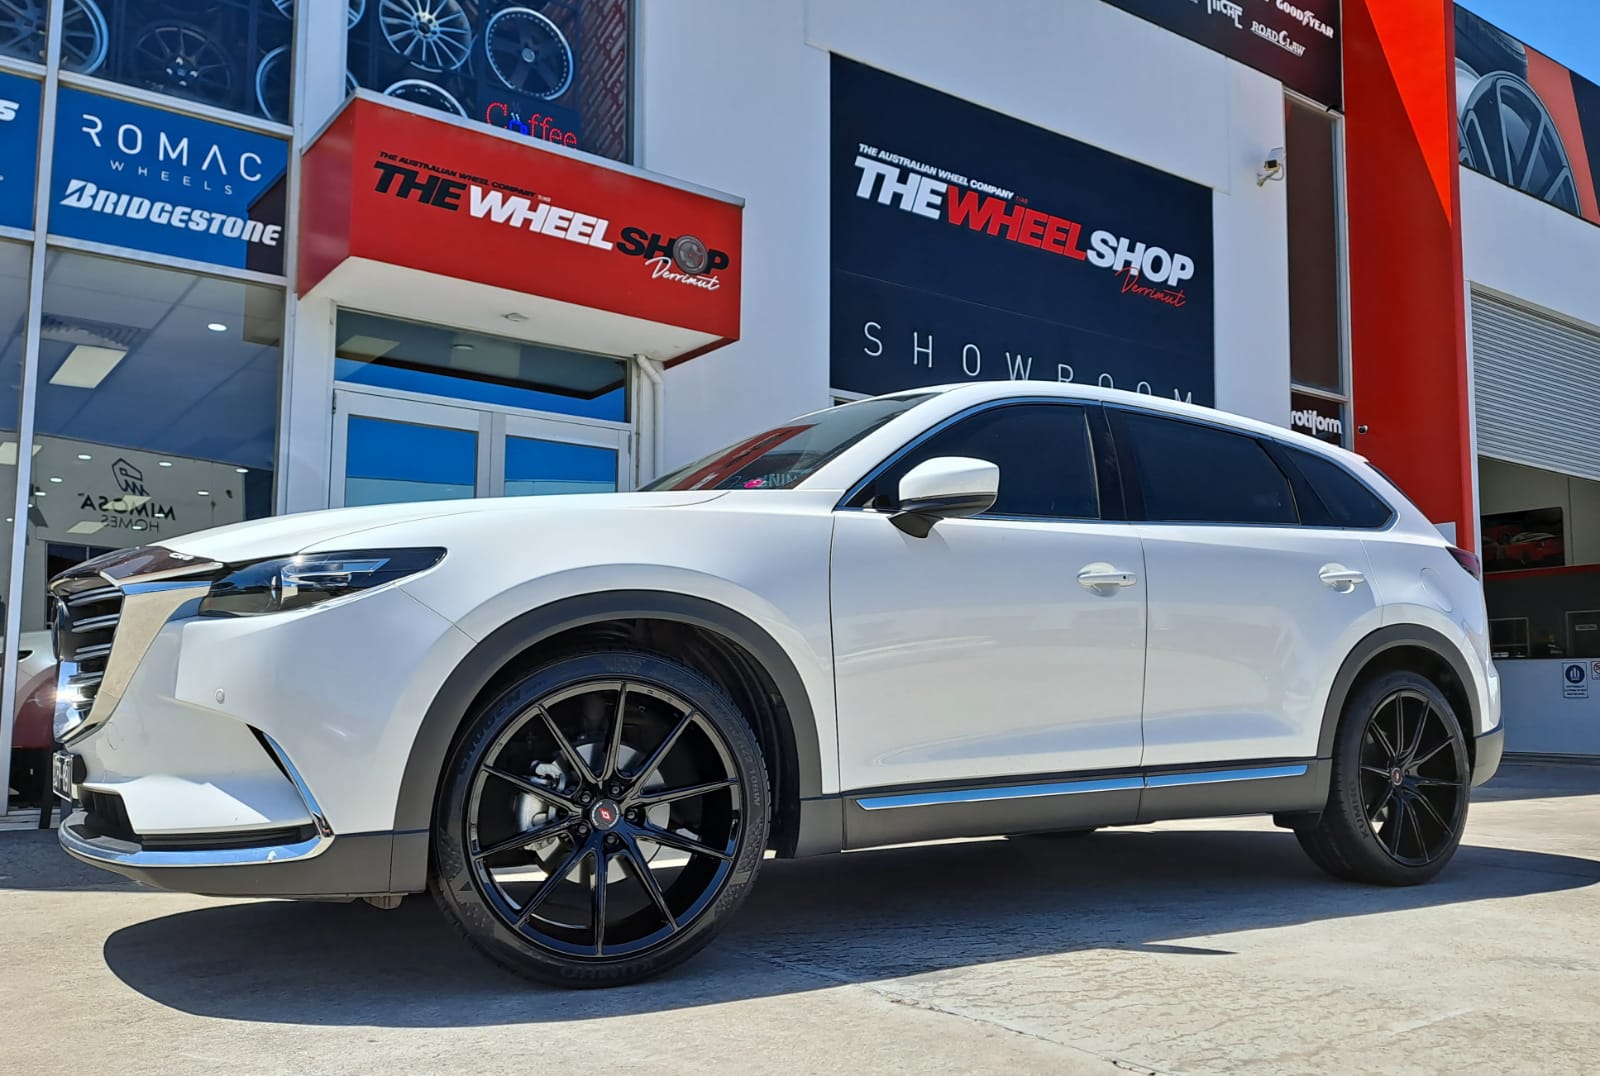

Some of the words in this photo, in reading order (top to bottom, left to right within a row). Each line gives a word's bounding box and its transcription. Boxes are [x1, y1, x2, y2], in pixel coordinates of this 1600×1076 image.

[1276, 0, 1334, 38] GOODYEAR
[80, 113, 263, 182] ROMAC
[110, 159, 233, 195] WHEELS
[379, 151, 397, 162] THE
[398, 156, 457, 178] AUSTRALIAN
[458, 172, 489, 188] WHEEL
[491, 180, 537, 198] COMPANY
[858, 143, 878, 157] THE
[878, 150, 937, 175] AUSTRALIAN
[938, 168, 969, 187] WHEEL
[970, 179, 1015, 200] COMPANY
[59, 178, 283, 247] BRIDGESTONE
[374, 160, 468, 211] THE
[469, 184, 614, 251] WHEEL
[854, 155, 948, 220] THE
[946, 184, 1087, 261] WHEEL
[1086, 229, 1195, 287] SHOP
[644, 257, 721, 291] Derrimut
[1114, 266, 1187, 308] Derrimut
[1290, 408, 1343, 436] rotiform
